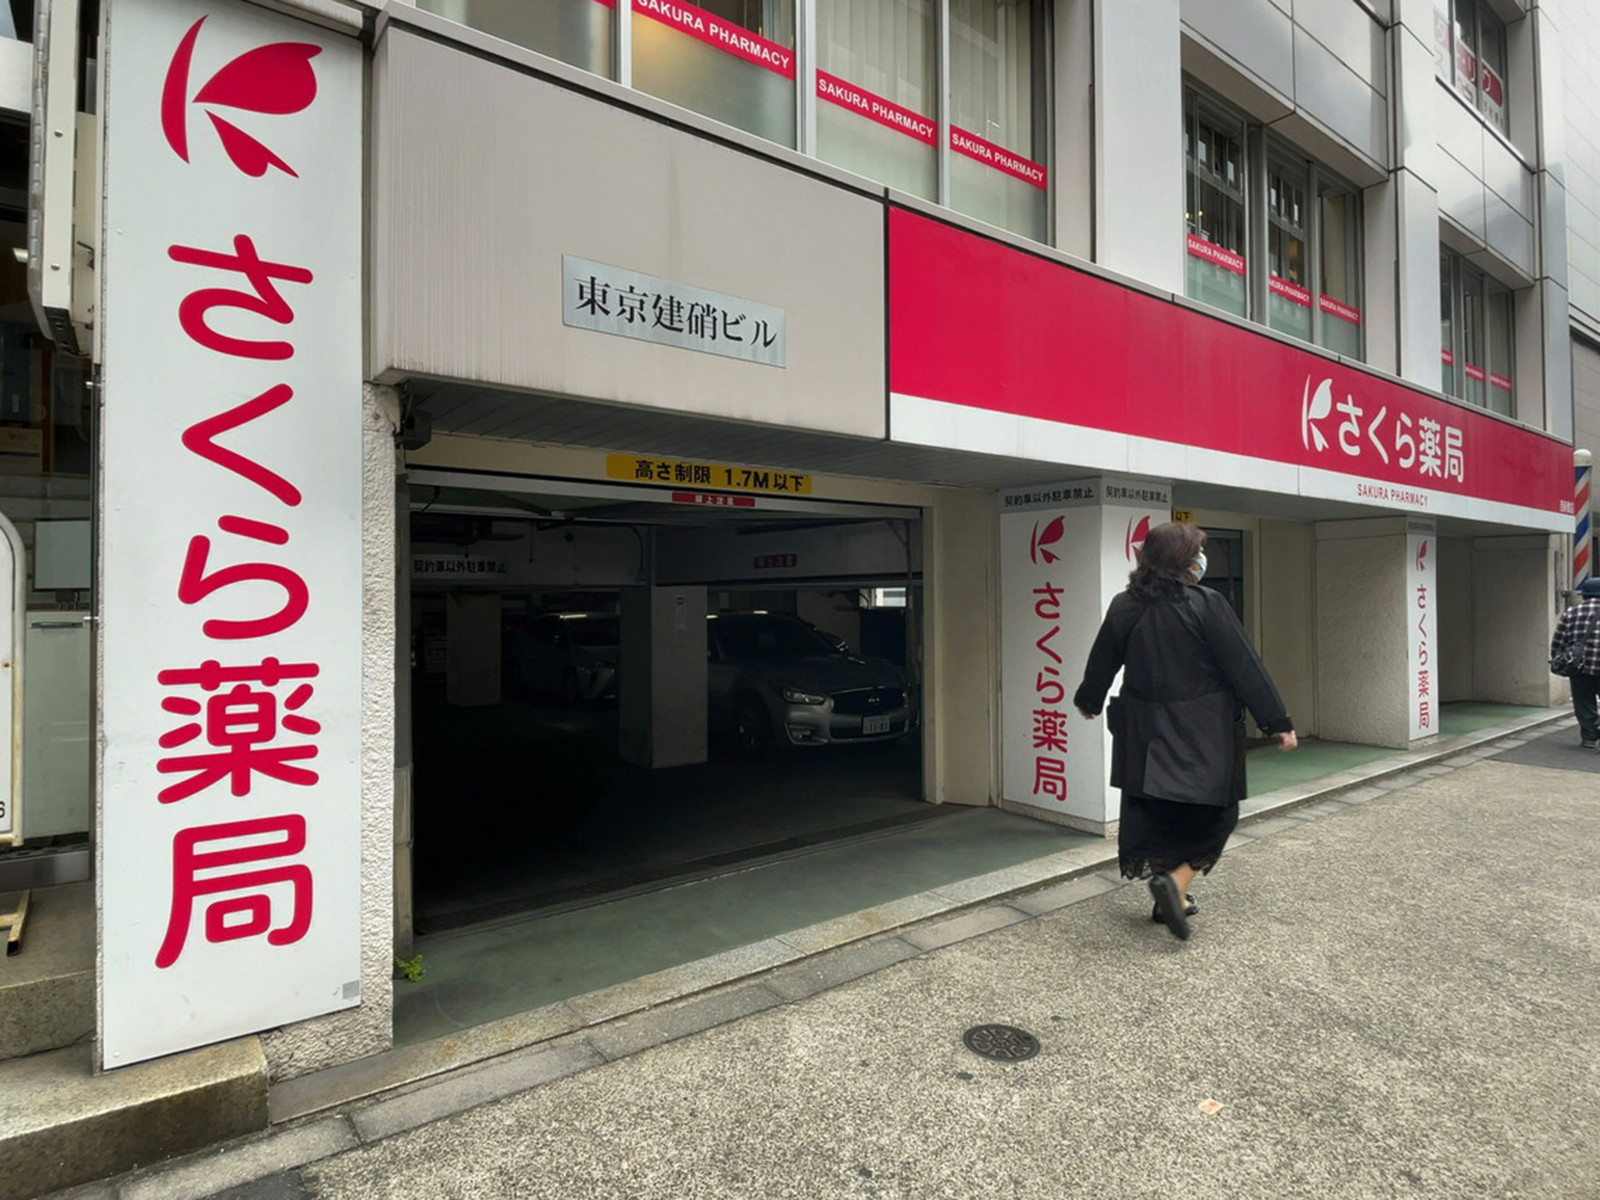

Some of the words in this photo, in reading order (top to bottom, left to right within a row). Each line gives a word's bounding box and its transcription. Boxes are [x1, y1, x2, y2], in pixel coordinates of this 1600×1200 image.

[709, 23, 789, 68] PHARMACY
[818, 78, 869, 111] SAKURA
[872, 102, 933, 138] PHARMACY
[952, 132, 992, 160] SAKURA
[994, 152, 1044, 182] PHARMACY
[1187, 238, 1212, 256] SAKURA
[1213, 250, 1243, 270] PHARMACY
[574, 275, 778, 348] 東京建硝ビル
[1335, 393, 1465, 484] さくら薬局
[634, 459, 711, 484] 高さ制限
[1004, 486, 1095, 507] 契約車以外駐車禁止
[1357, 483, 1389, 500] SAKURA
[1391, 489, 1429, 507] PHARMACY
[155, 234, 321, 968] さくら薬局
[1416, 583, 1430, 730] さくら薬局
[1033, 582, 1068, 802] さくら薬局
